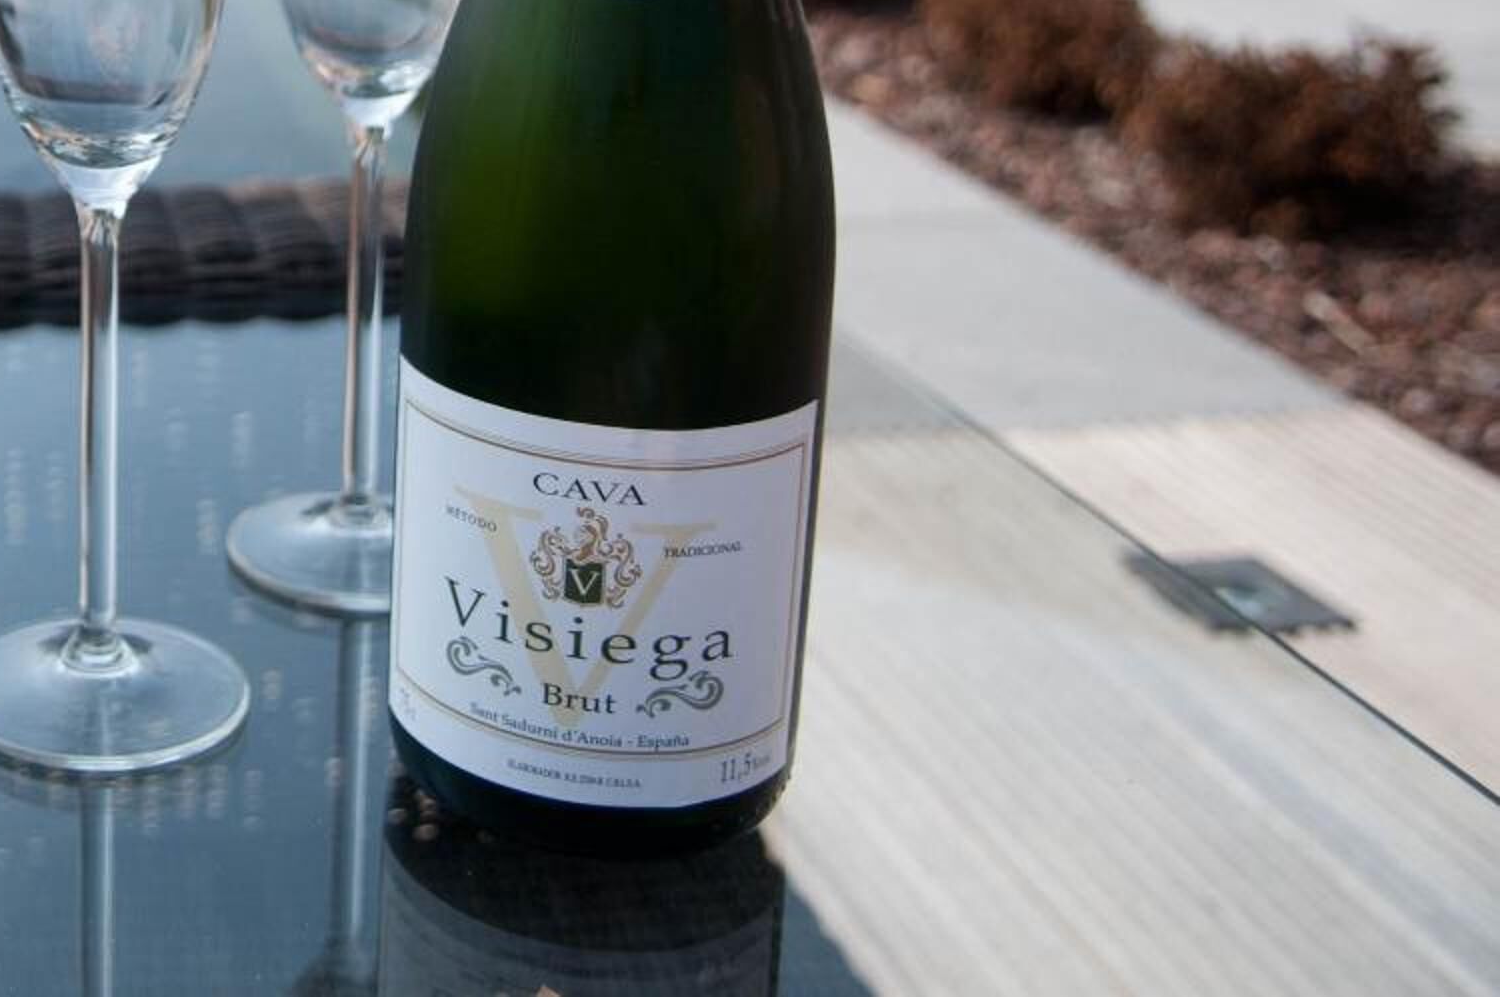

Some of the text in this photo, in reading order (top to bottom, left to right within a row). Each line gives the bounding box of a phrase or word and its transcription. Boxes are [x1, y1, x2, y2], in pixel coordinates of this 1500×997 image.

[533, 471, 647, 507] CAVA
[663, 540, 743, 558] TRADICIONAL
[570, 568, 601, 595] V
[444, 575, 732, 681] Visiega
[542, 682, 617, 715] Brut
[470, 702, 499, 722] Sant
[636, 734, 690, 753] España
